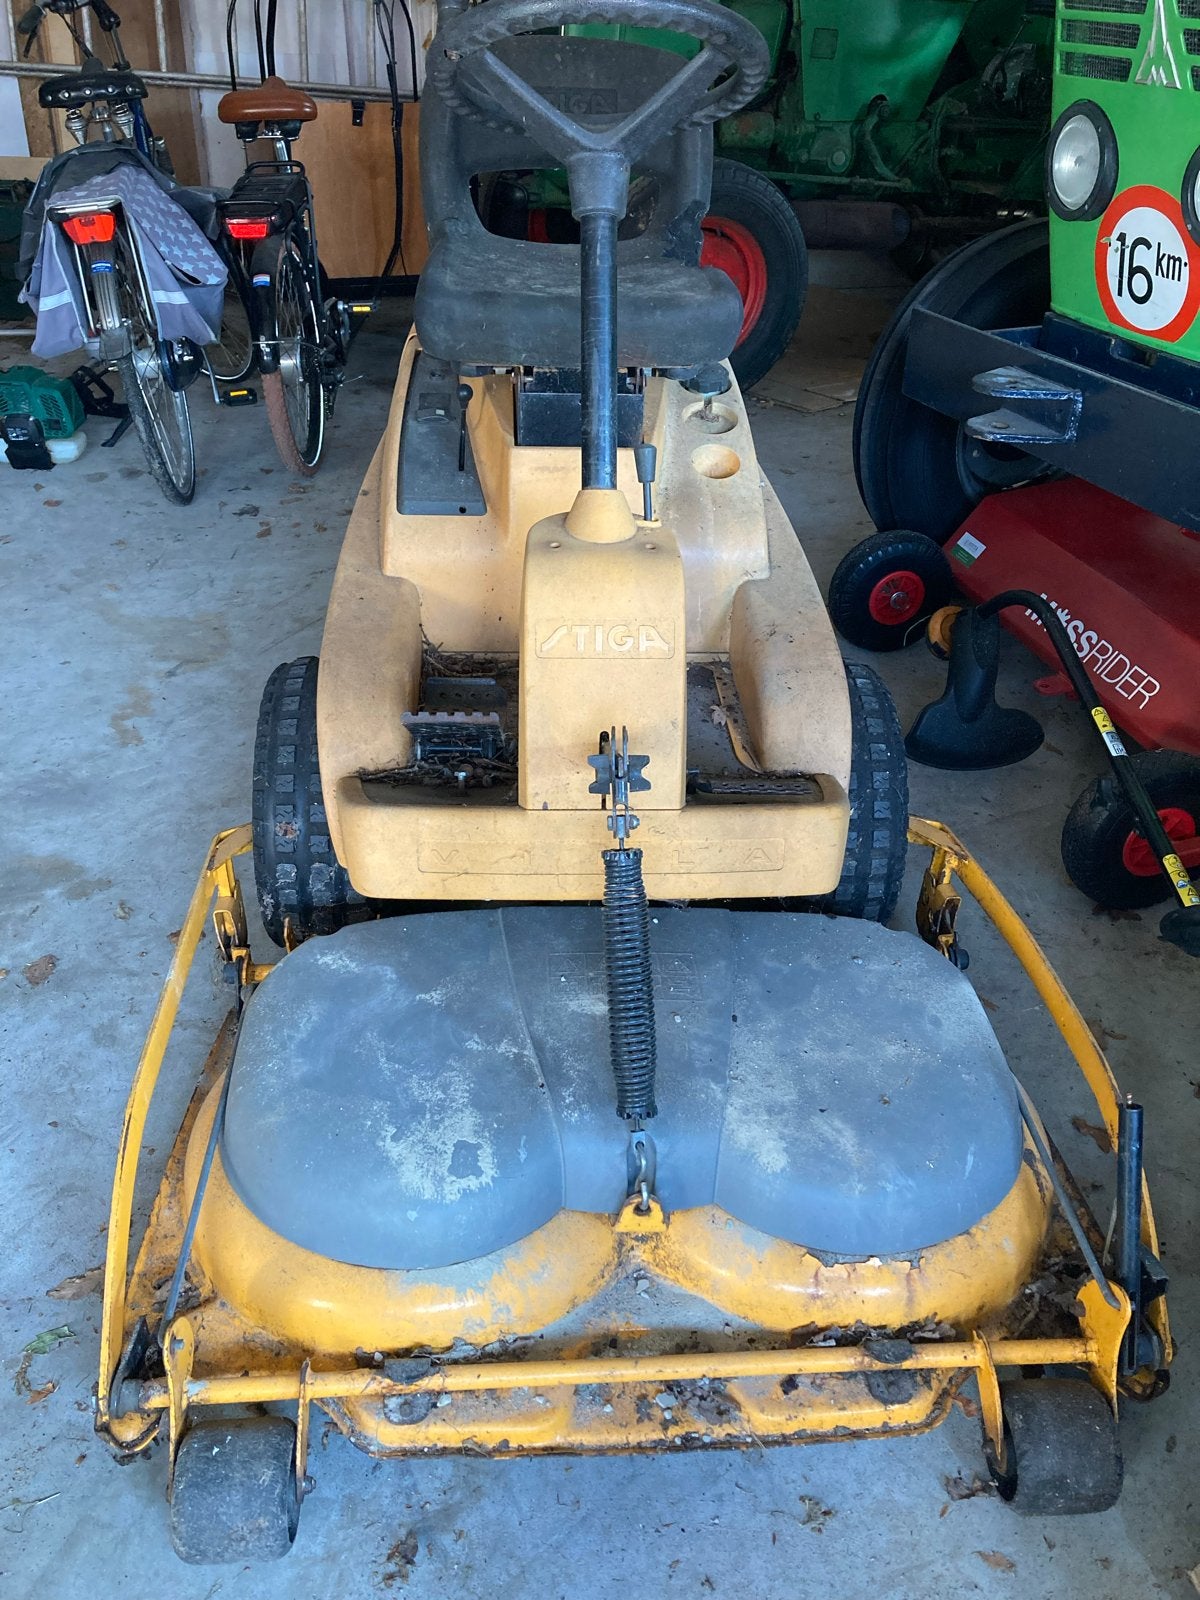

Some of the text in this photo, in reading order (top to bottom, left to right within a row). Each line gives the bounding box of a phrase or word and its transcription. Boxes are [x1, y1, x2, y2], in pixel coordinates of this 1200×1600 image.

[1116, 232, 1153, 305] 16
[541, 624, 669, 653] STIGA
[431, 848, 774, 866] VILA
